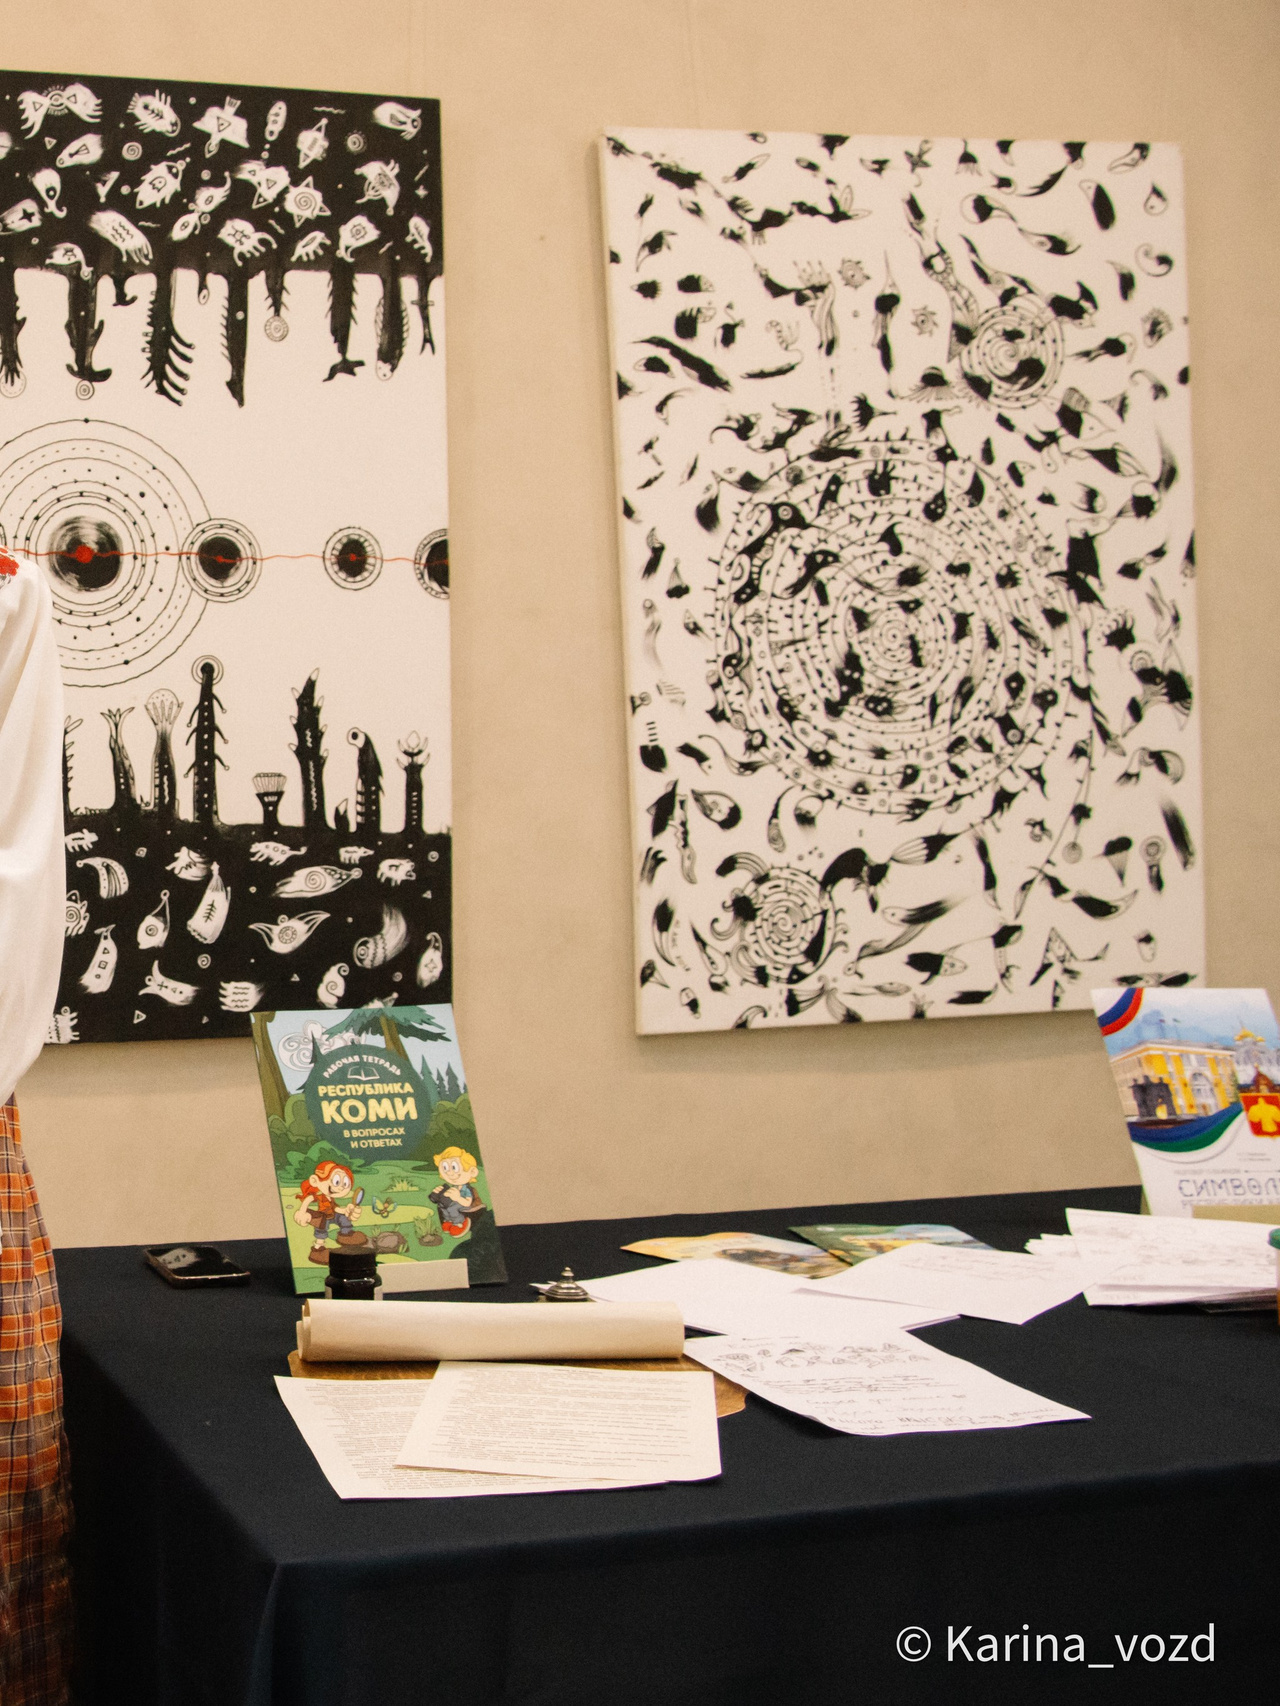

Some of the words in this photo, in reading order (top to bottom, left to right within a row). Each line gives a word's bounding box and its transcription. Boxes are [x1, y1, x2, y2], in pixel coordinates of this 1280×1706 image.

[323, 1055, 360, 1078] РАБОЧАЯ
[362, 1055, 401, 1076] ТЕТРАДЬ
[318, 1082, 414, 1097] РЕСПУБЛИКА
[321, 1097, 418, 1124] КОМИ
[343, 1129, 351, 1138] В
[351, 1127, 406, 1138] ВОПРОСАХ
[350, 1140, 358, 1148] И
[360, 1139, 402, 1148] ОТВЕТАХ
[1178, 1177, 1280, 1197] СИМВОЛ
